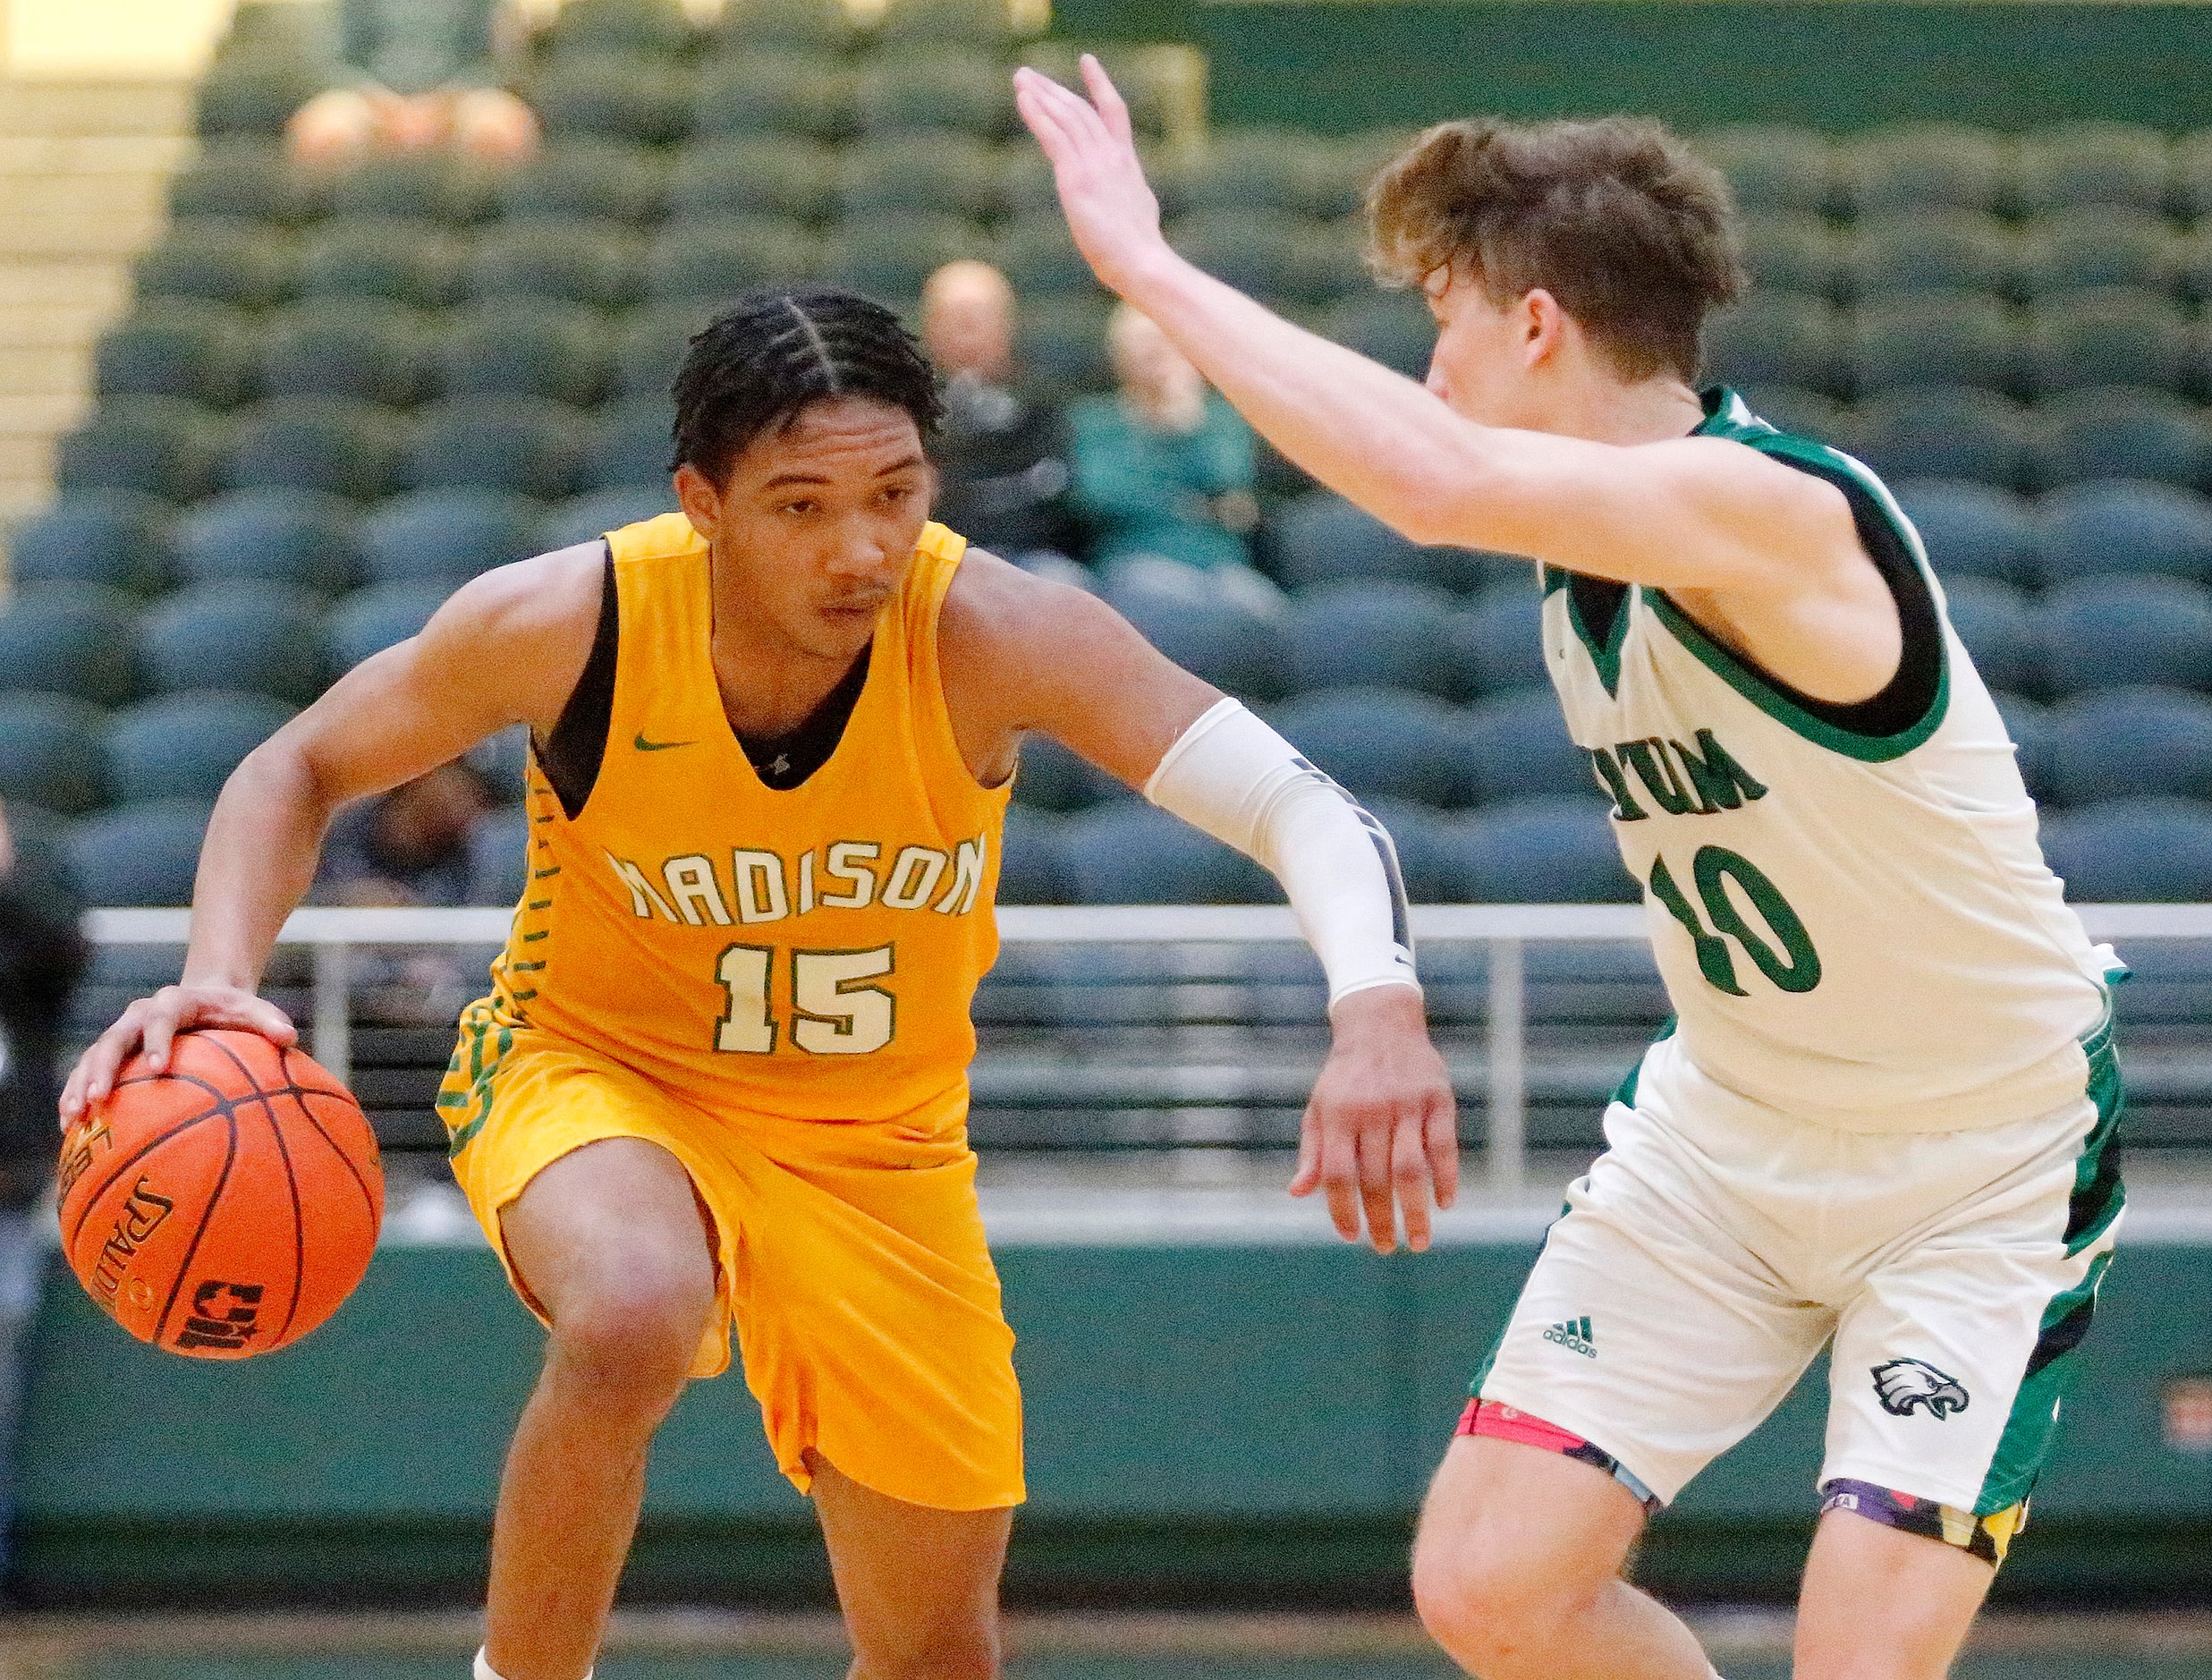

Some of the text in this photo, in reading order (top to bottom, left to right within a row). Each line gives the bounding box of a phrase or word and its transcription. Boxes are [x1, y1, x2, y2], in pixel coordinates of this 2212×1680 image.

[602, 831, 986, 926] MADISON
[1649, 844, 1822, 997] 10
[713, 942, 895, 1055] 15
[1543, 1329, 1598, 1359] adidas
